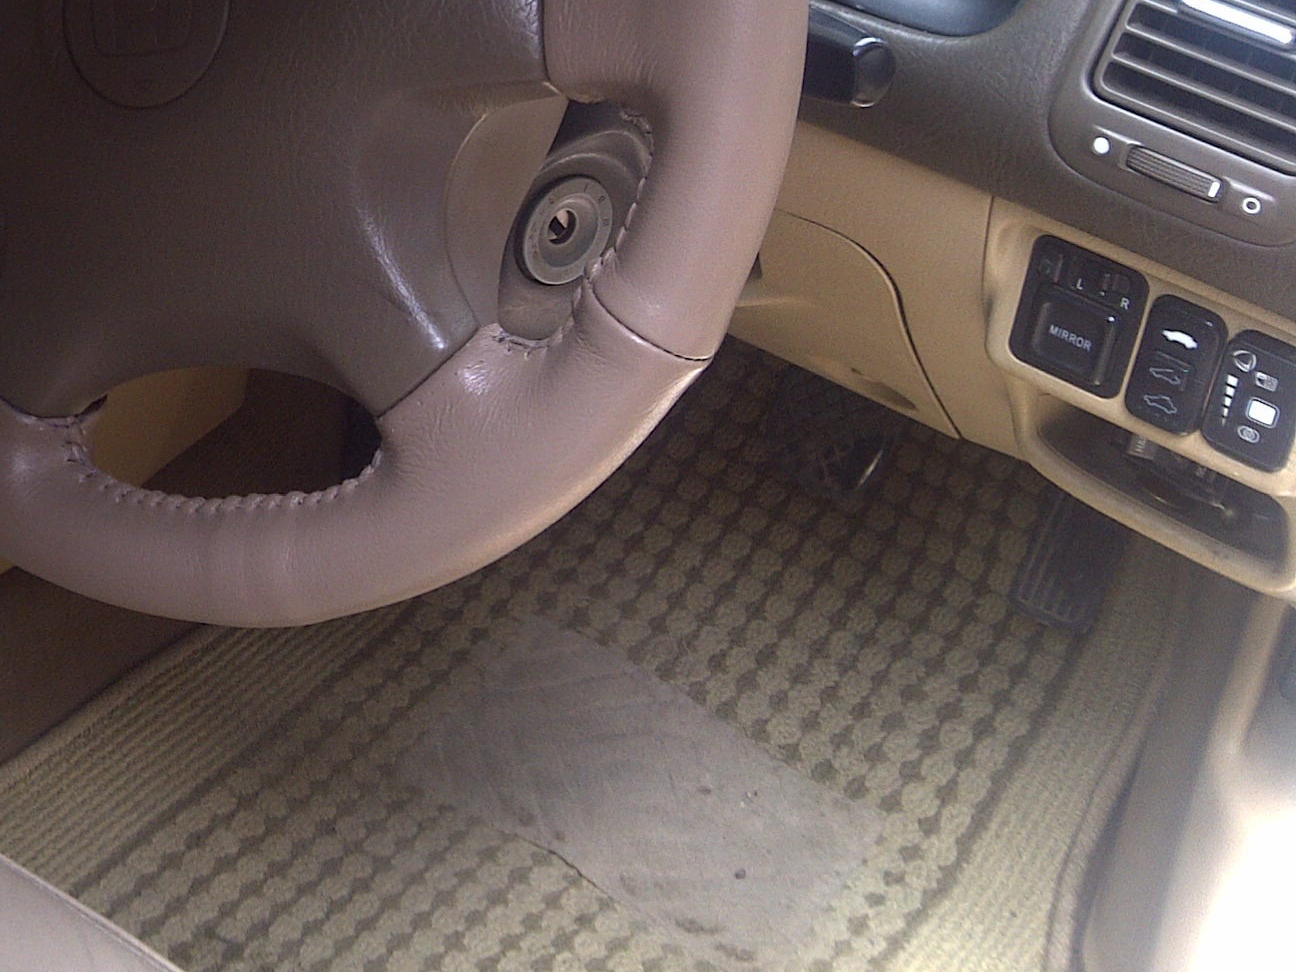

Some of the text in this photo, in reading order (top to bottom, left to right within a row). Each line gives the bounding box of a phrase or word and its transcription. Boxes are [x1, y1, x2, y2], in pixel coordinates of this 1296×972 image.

[1075, 278, 1130, 310] L R
[1049, 324, 1092, 352] MIRROR
